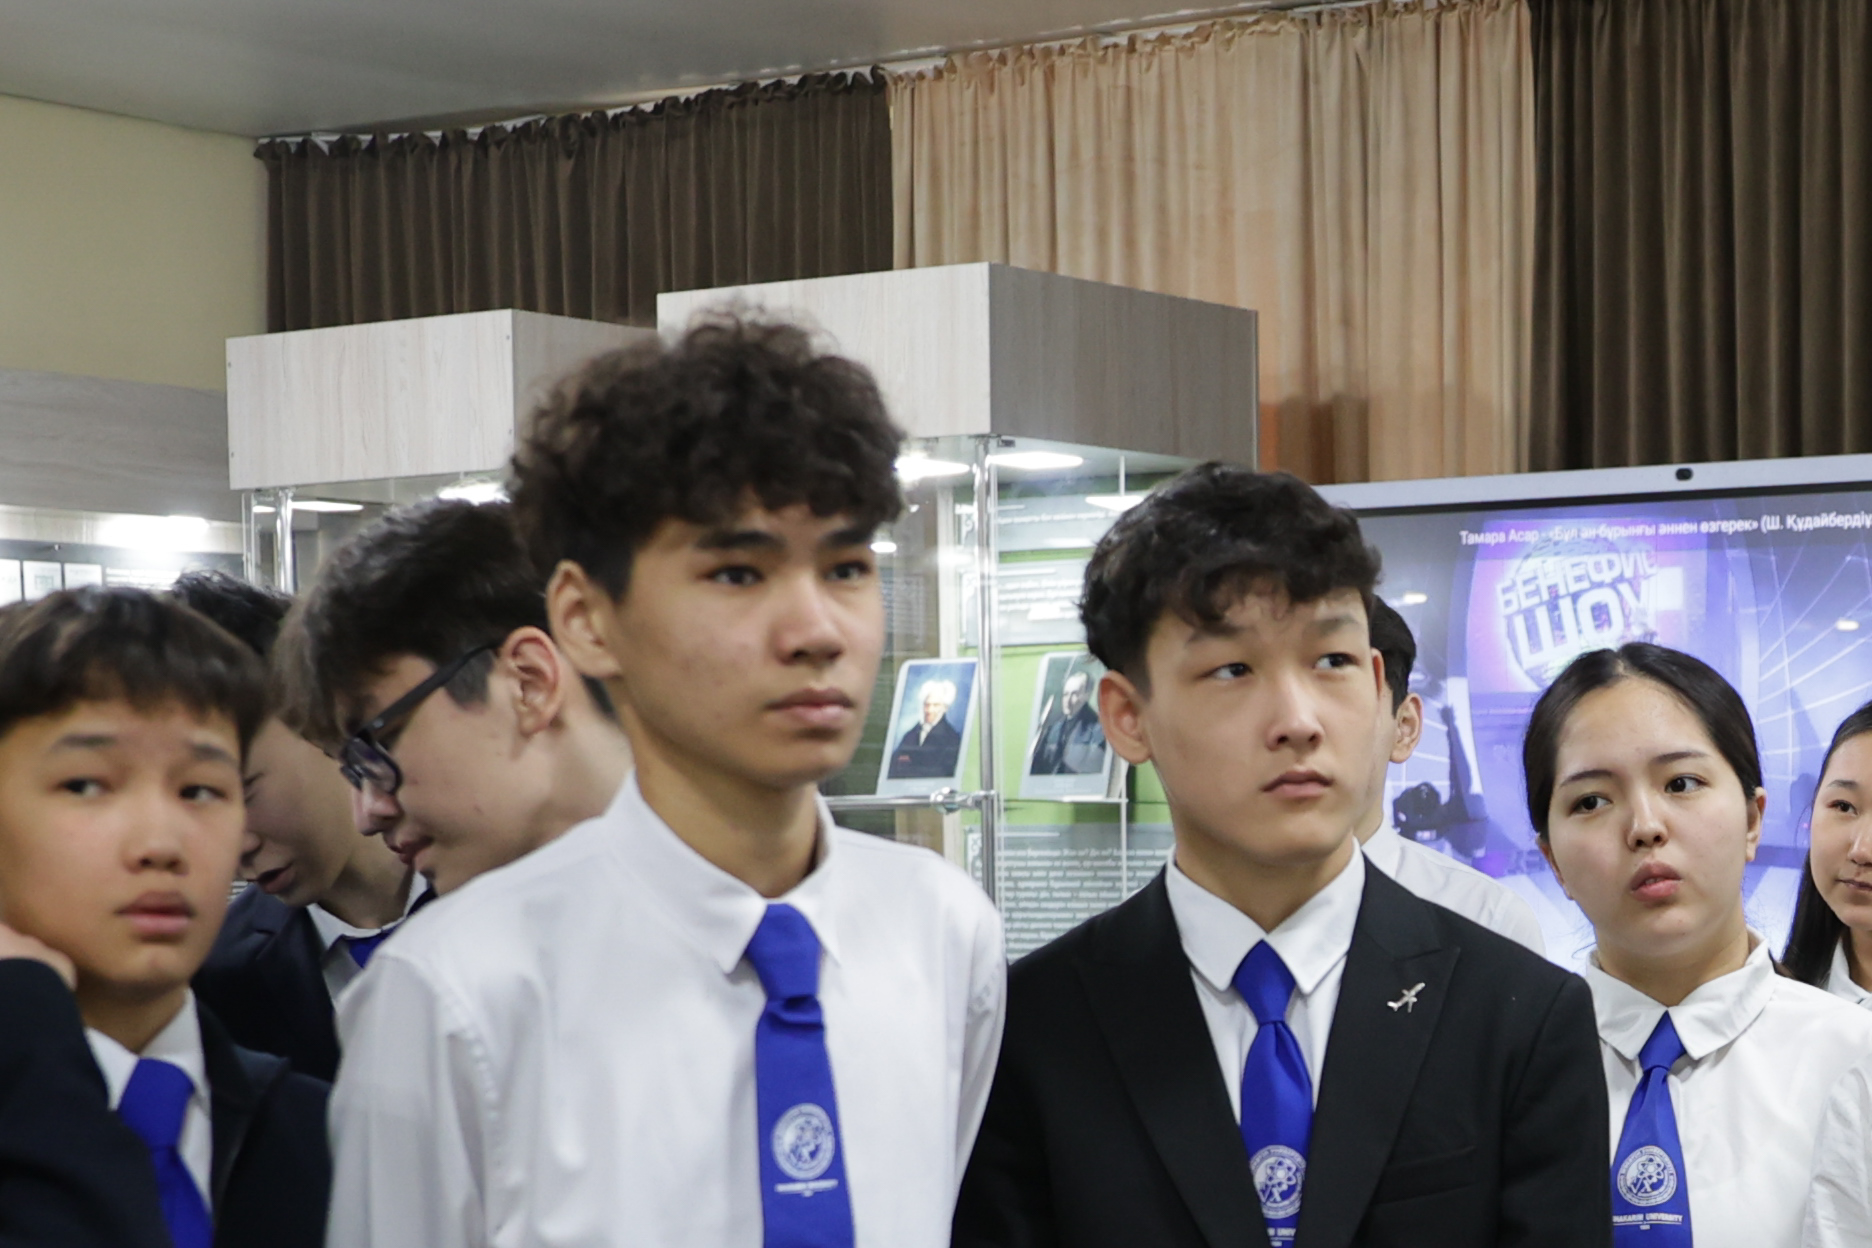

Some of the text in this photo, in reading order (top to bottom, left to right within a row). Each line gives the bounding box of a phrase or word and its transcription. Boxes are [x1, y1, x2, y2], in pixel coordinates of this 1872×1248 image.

[1460, 530, 1506, 546] Тамара
[1508, 528, 1540, 545] Асар
[1760, 514, 1784, 534] (Ш.
[1645, 1212, 1683, 1223] UNIVERSITY
